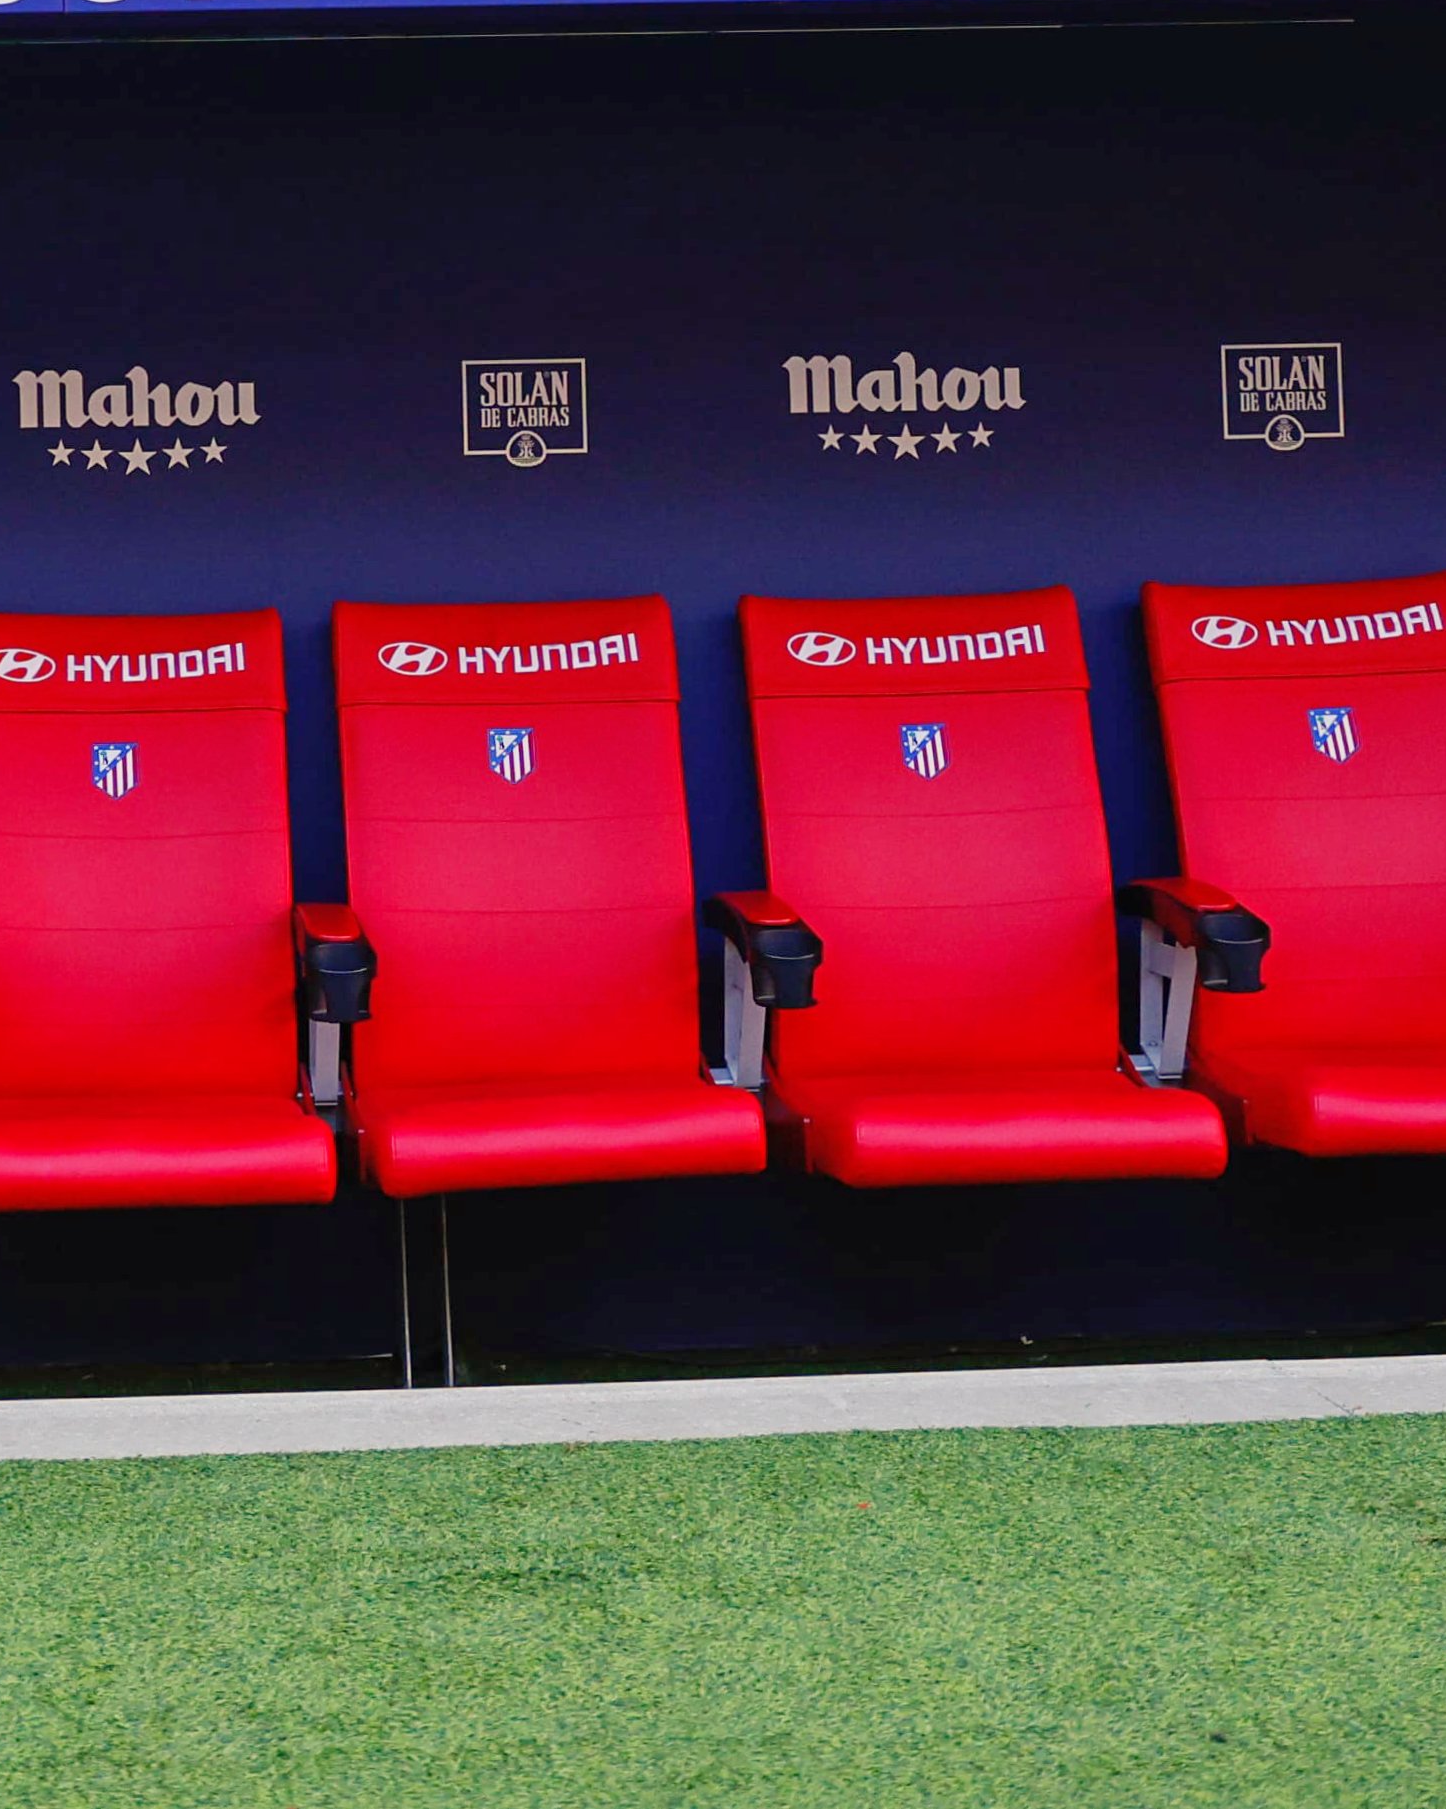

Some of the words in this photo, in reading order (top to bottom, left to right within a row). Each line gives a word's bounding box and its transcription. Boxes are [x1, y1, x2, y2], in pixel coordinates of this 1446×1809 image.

[480, 371, 568, 406] SOLAN
[782, 352, 1026, 413] Mahou
[1239, 355, 1324, 391] SOLAN
[12, 366, 261, 428] Mahou
[1240, 393, 1259, 412] DE
[1266, 391, 1326, 411] CABRAS
[481, 408, 500, 427] DE
[507, 407, 569, 427] CABRAS
[1266, 603, 1442, 645] HYUNDAI
[68, 643, 244, 682] HYUNDAI
[459, 633, 638, 673] HYUNDAI
[866, 625, 1044, 664] HYUNDAI
